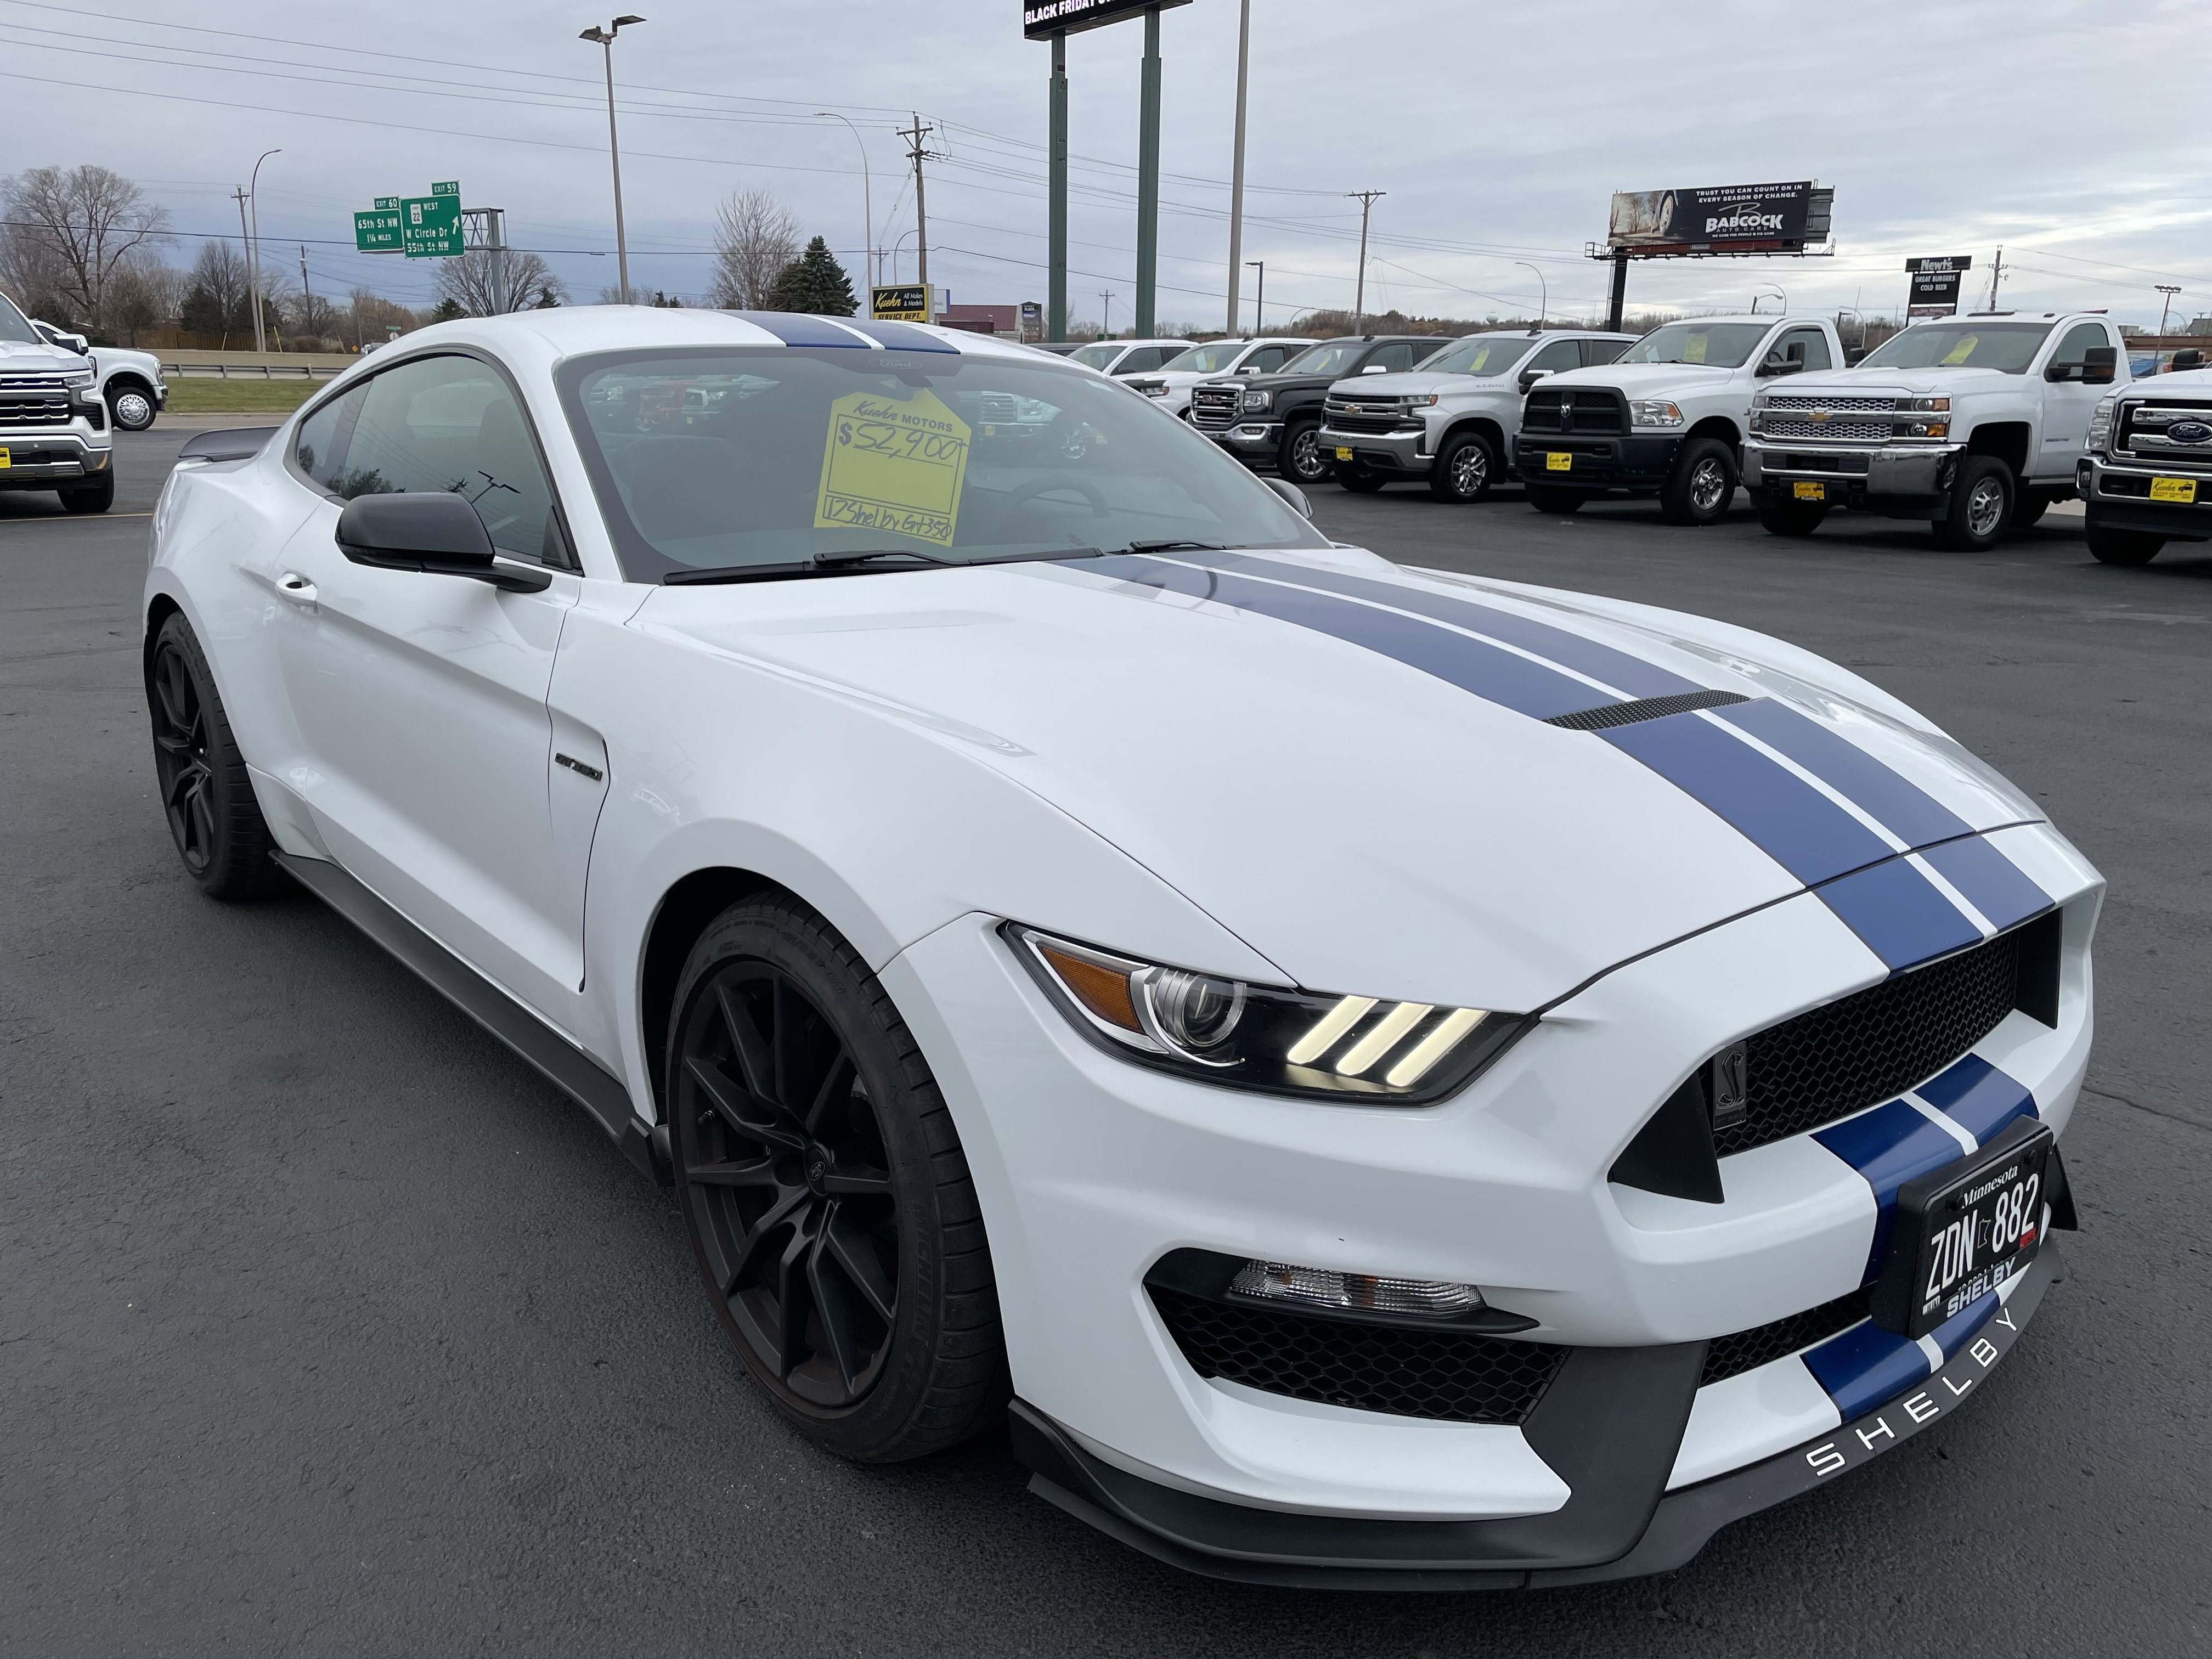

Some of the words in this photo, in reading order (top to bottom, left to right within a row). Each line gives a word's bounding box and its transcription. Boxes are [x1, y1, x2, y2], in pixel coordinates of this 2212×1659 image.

[1025, 3, 1057, 25] BLACK
[447, 183, 457, 193] 59
[376, 200, 386, 208] EXIT
[388, 198, 398, 208] 60
[423, 202, 438, 211] WEST
[358, 219, 374, 229] 65th
[377, 218, 385, 228] St
[387, 217, 398, 227] NW
[413, 212, 421, 222] 22
[1705, 214, 1784, 234] BABCOCK
[406, 229, 411, 239] W
[415, 228, 436, 238] Circle
[439, 227, 448, 237] Dr
[407, 242, 425, 252] 55th
[427, 242, 436, 252] St
[438, 241, 449, 251] NW
[1920, 257, 1953, 271] Newt's
[875, 291, 901, 309] Kuehn
[853, 400, 899, 421] Kuehn
[901, 414, 953, 432] MOTORS
[2176, 425, 2202, 436] Ford
[1962, 1165, 2018, 1209] Minnesota
[1926, 1209, 1978, 1300] ZDN
[1992, 1173, 2040, 1253] 882
[1946, 1256, 2017, 1318] SHELBY
[1806, 1307, 2017, 1477] SHELBY
